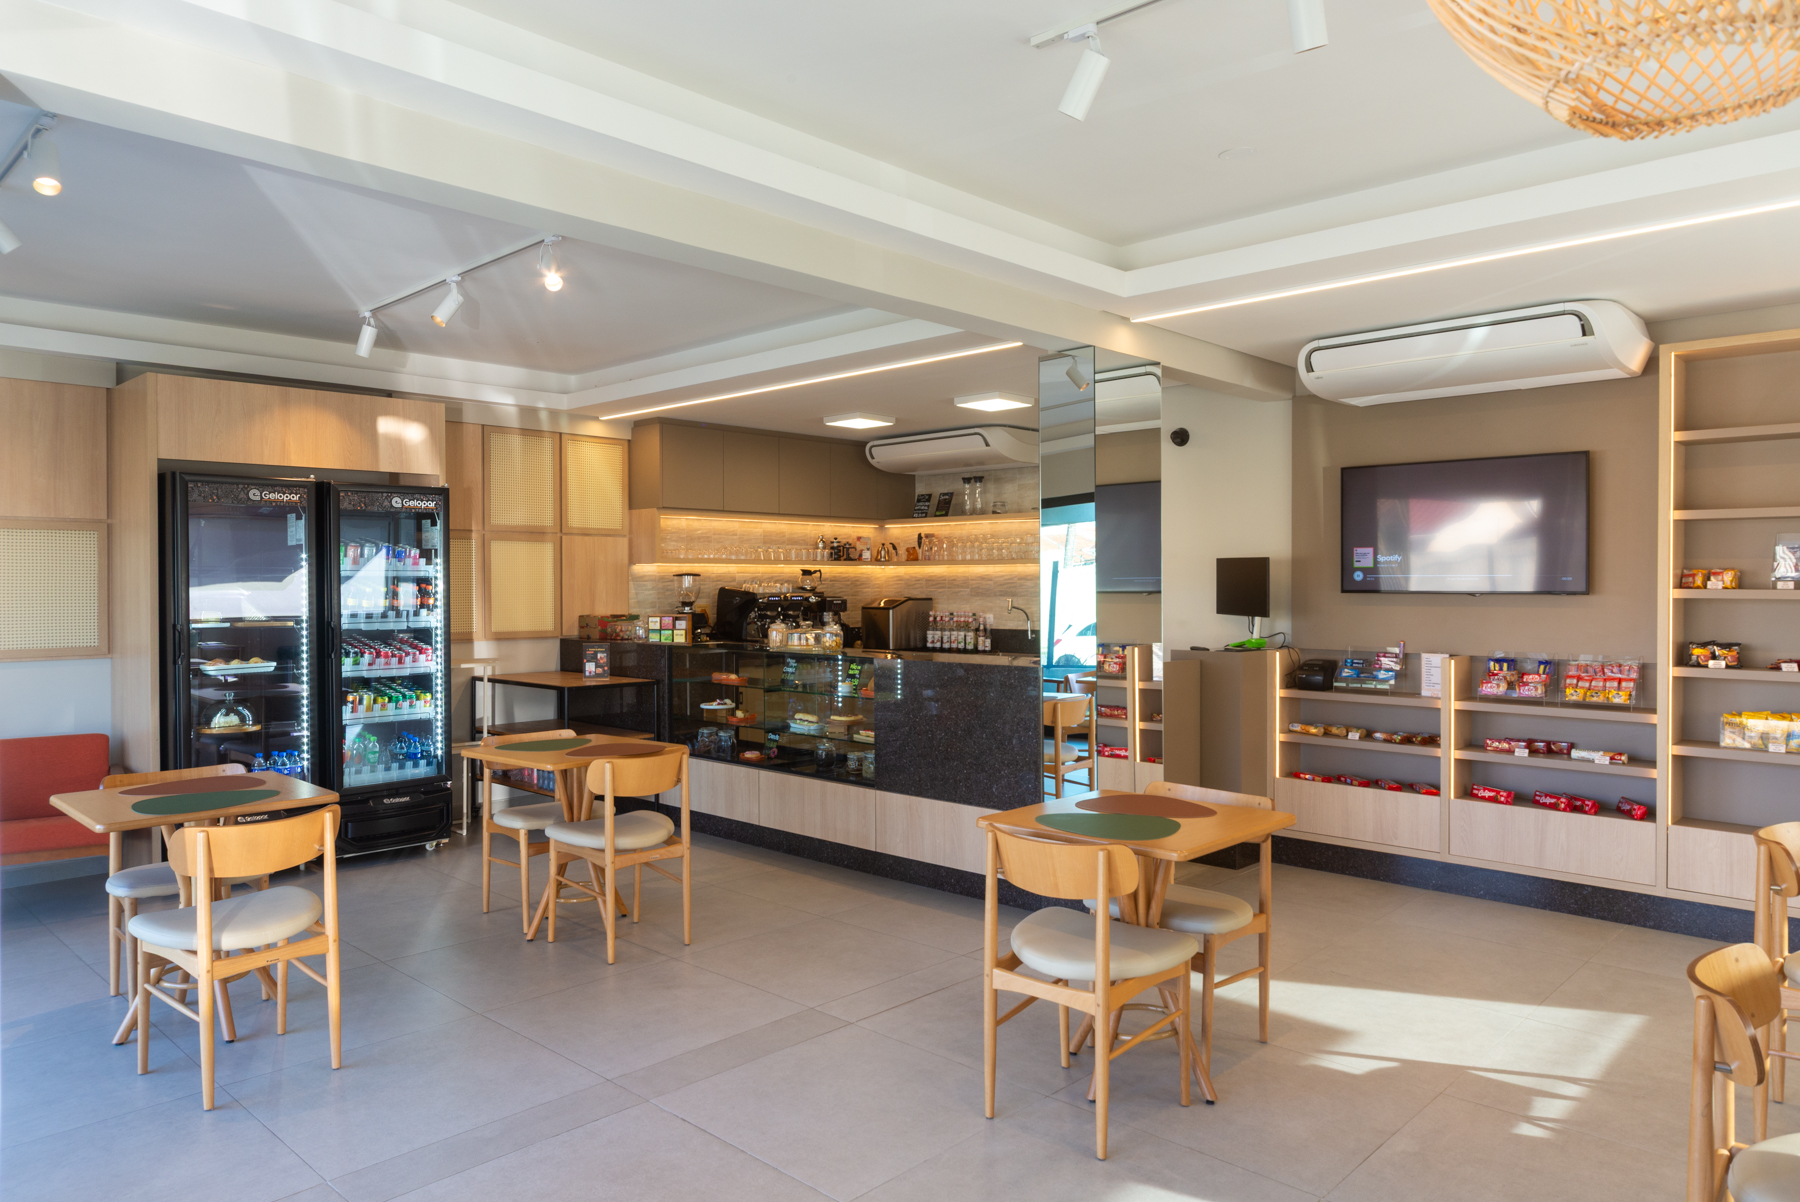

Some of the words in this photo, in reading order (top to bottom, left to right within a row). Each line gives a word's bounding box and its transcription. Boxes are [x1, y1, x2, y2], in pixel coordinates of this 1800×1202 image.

[261, 491, 301, 502] Gelopar
[402, 499, 436, 509] Gelopar
[1377, 554, 1402, 562] Spotify
